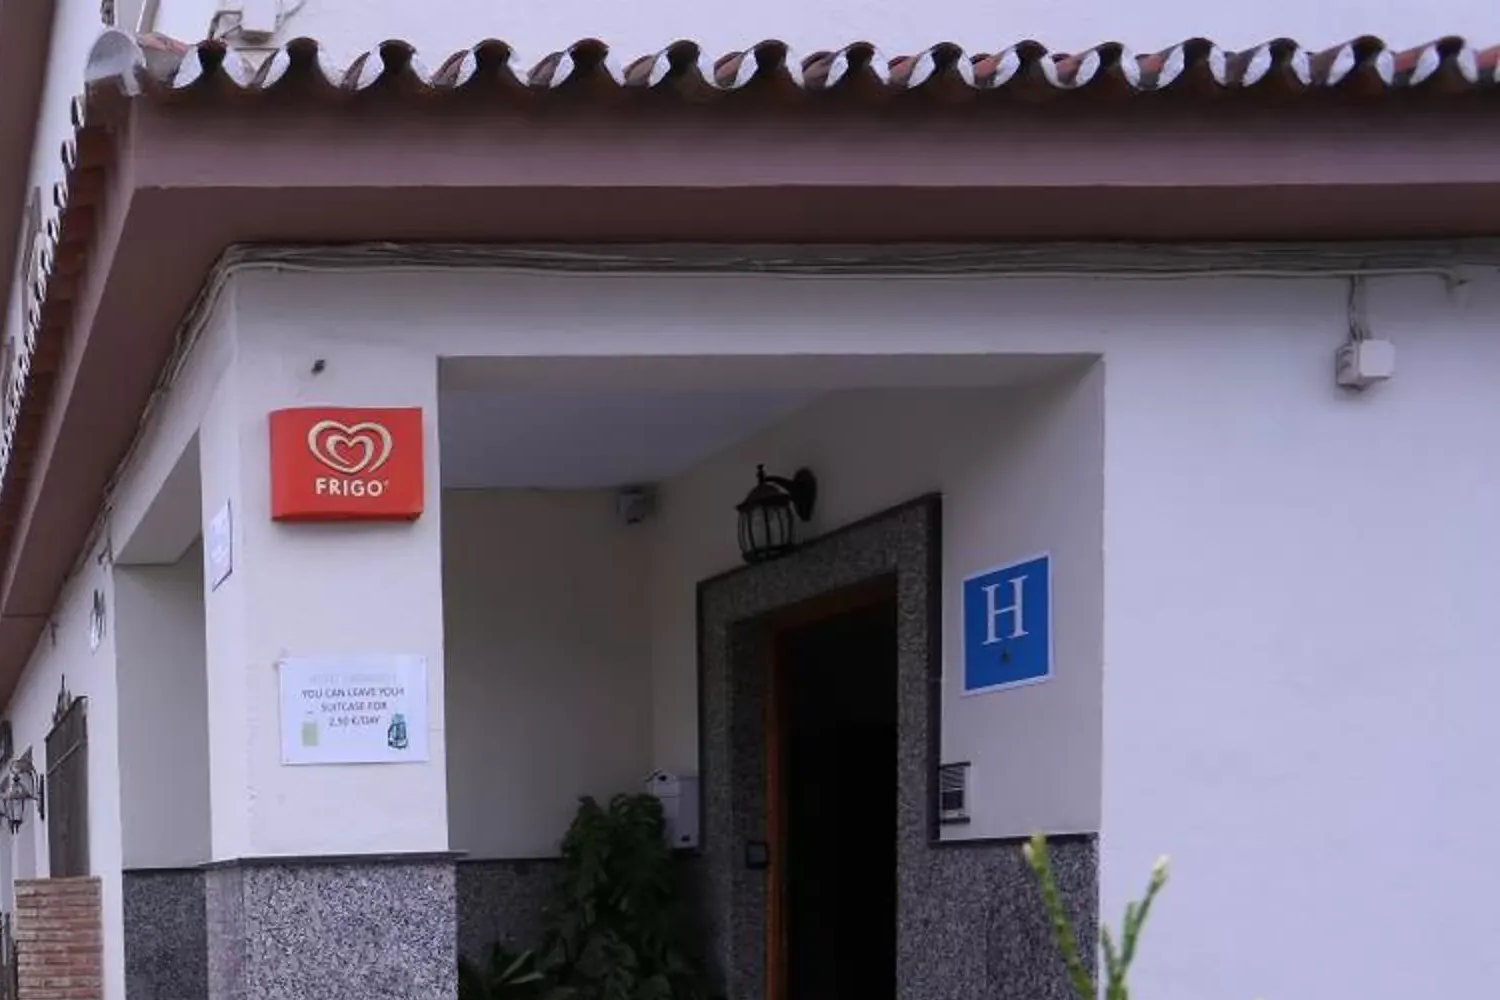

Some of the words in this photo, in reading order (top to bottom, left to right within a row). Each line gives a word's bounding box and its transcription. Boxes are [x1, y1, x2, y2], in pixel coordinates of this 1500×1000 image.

[315, 477, 384, 497] FRIGO
[981, 575, 1029, 646] H
[301, 689, 323, 699] YOU
[325, 688, 345, 698] CAN
[347, 687, 376, 697] LEAVE
[379, 686, 405, 697] YOUR
[320, 701, 364, 712] SUITCASE
[367, 701, 387, 710] FOR
